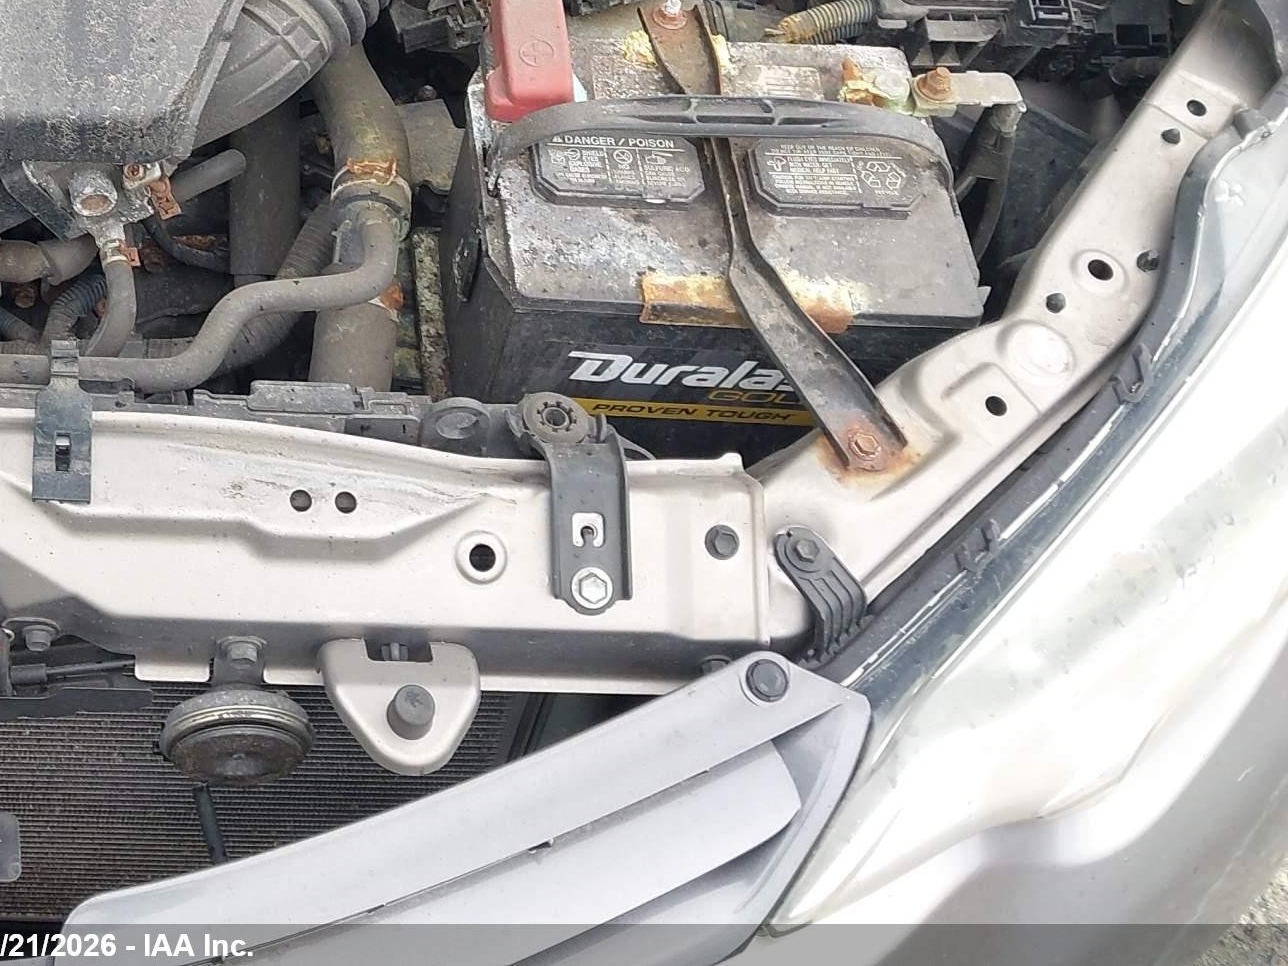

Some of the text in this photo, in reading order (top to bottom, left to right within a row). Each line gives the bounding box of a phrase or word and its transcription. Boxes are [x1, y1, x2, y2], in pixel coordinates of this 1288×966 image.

[564, 135, 674, 148] DANGER / POISON
[707, 389, 801, 405] GOL
[592, 402, 793, 422] PROVEN TOUGH
